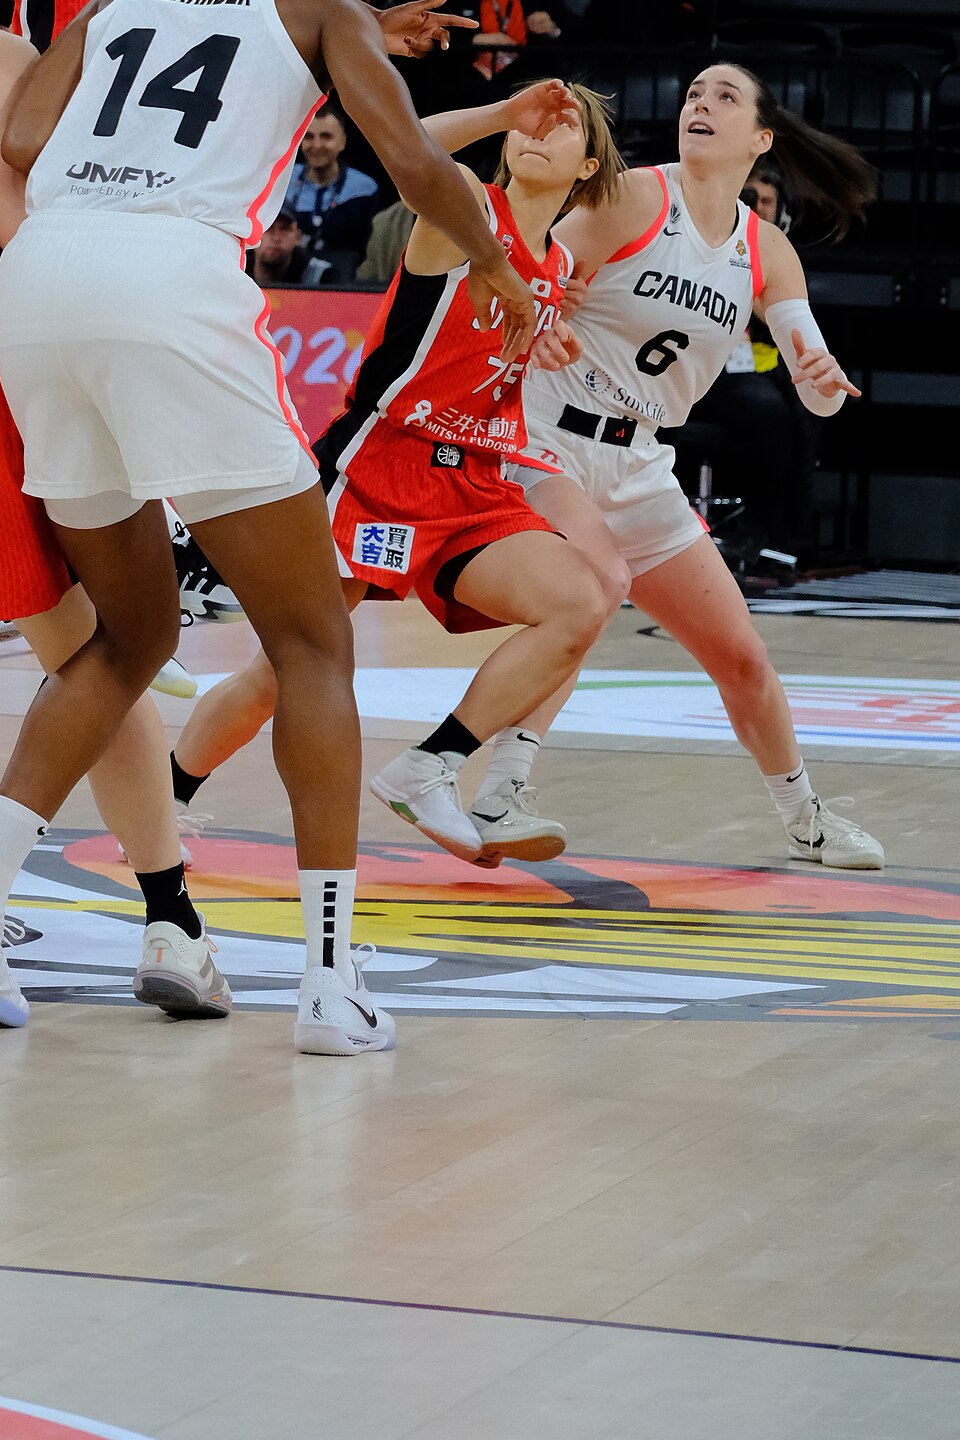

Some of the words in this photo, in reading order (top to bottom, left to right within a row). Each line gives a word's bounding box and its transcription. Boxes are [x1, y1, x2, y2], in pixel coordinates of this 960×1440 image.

[92, 27, 241, 149] 14
[66, 161, 170, 189] UNIFY
[633, 270, 738, 336] CANADA
[635, 329, 690, 377] 6
[471, 354, 525, 402] 75
